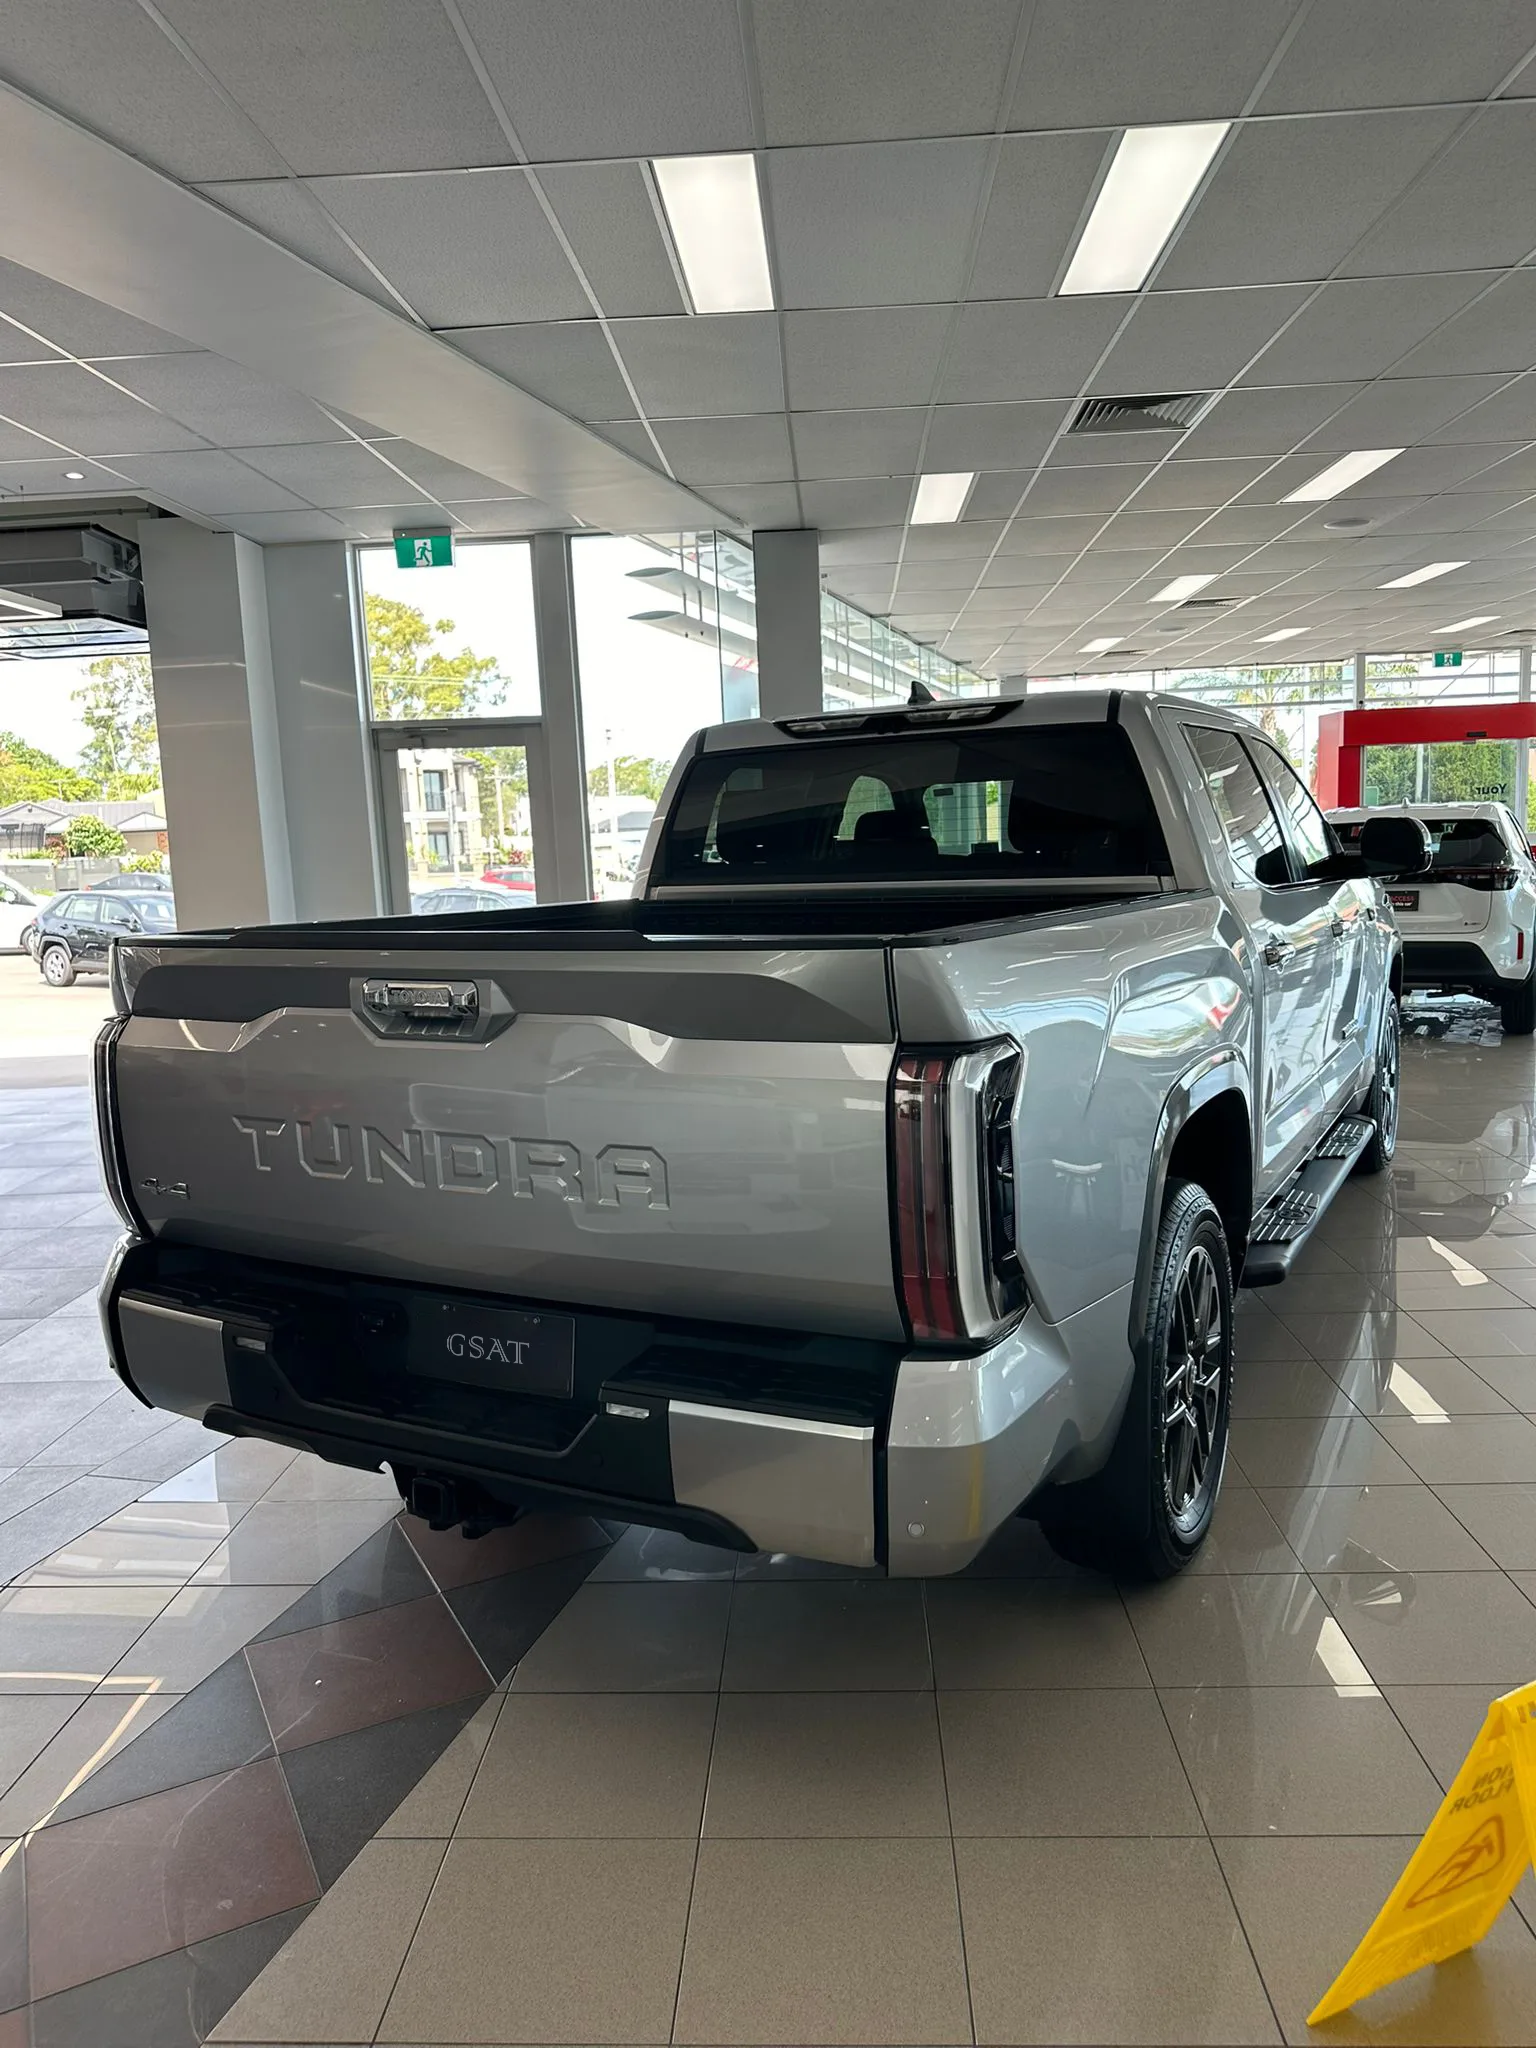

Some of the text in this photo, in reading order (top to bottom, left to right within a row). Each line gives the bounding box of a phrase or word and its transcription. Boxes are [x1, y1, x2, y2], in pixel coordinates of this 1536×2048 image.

[391, 988, 448, 1005] TOYOTA
[232, 1114, 671, 1211] TUNDRA
[446, 1333, 530, 1365] GSAT
